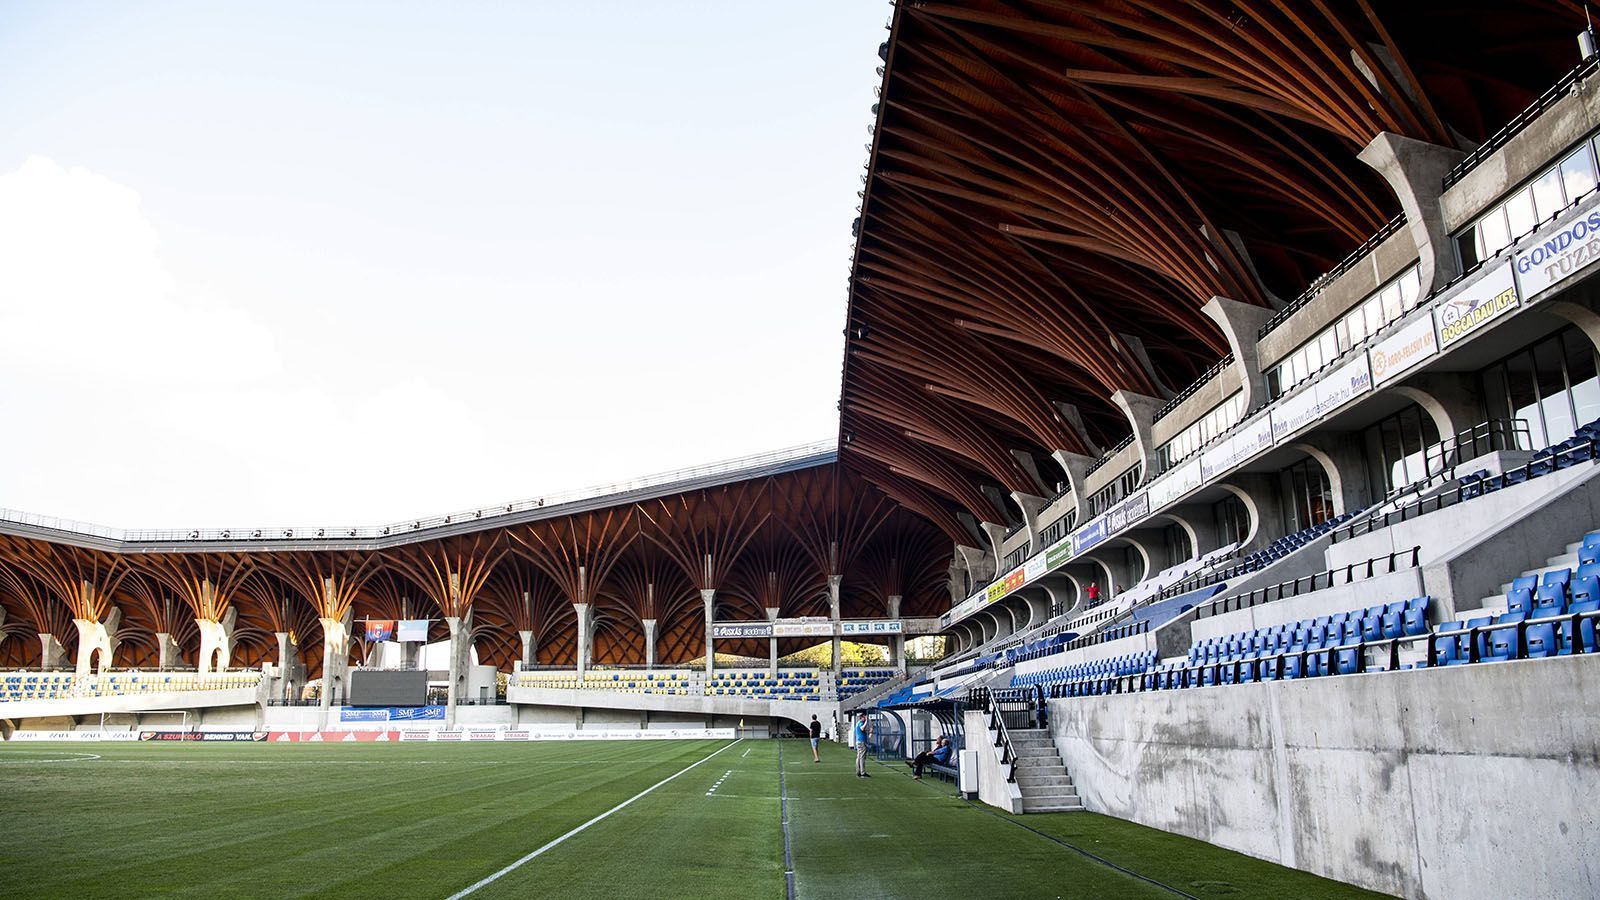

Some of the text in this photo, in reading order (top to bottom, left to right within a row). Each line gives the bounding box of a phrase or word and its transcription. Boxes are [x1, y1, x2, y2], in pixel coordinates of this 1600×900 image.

[1518, 212, 1600, 274] GONDOS
[1442, 313, 1474, 343] BOGCA
[1473, 299, 1494, 324] BAU
[399, 708, 441, 716] SMP SMP
